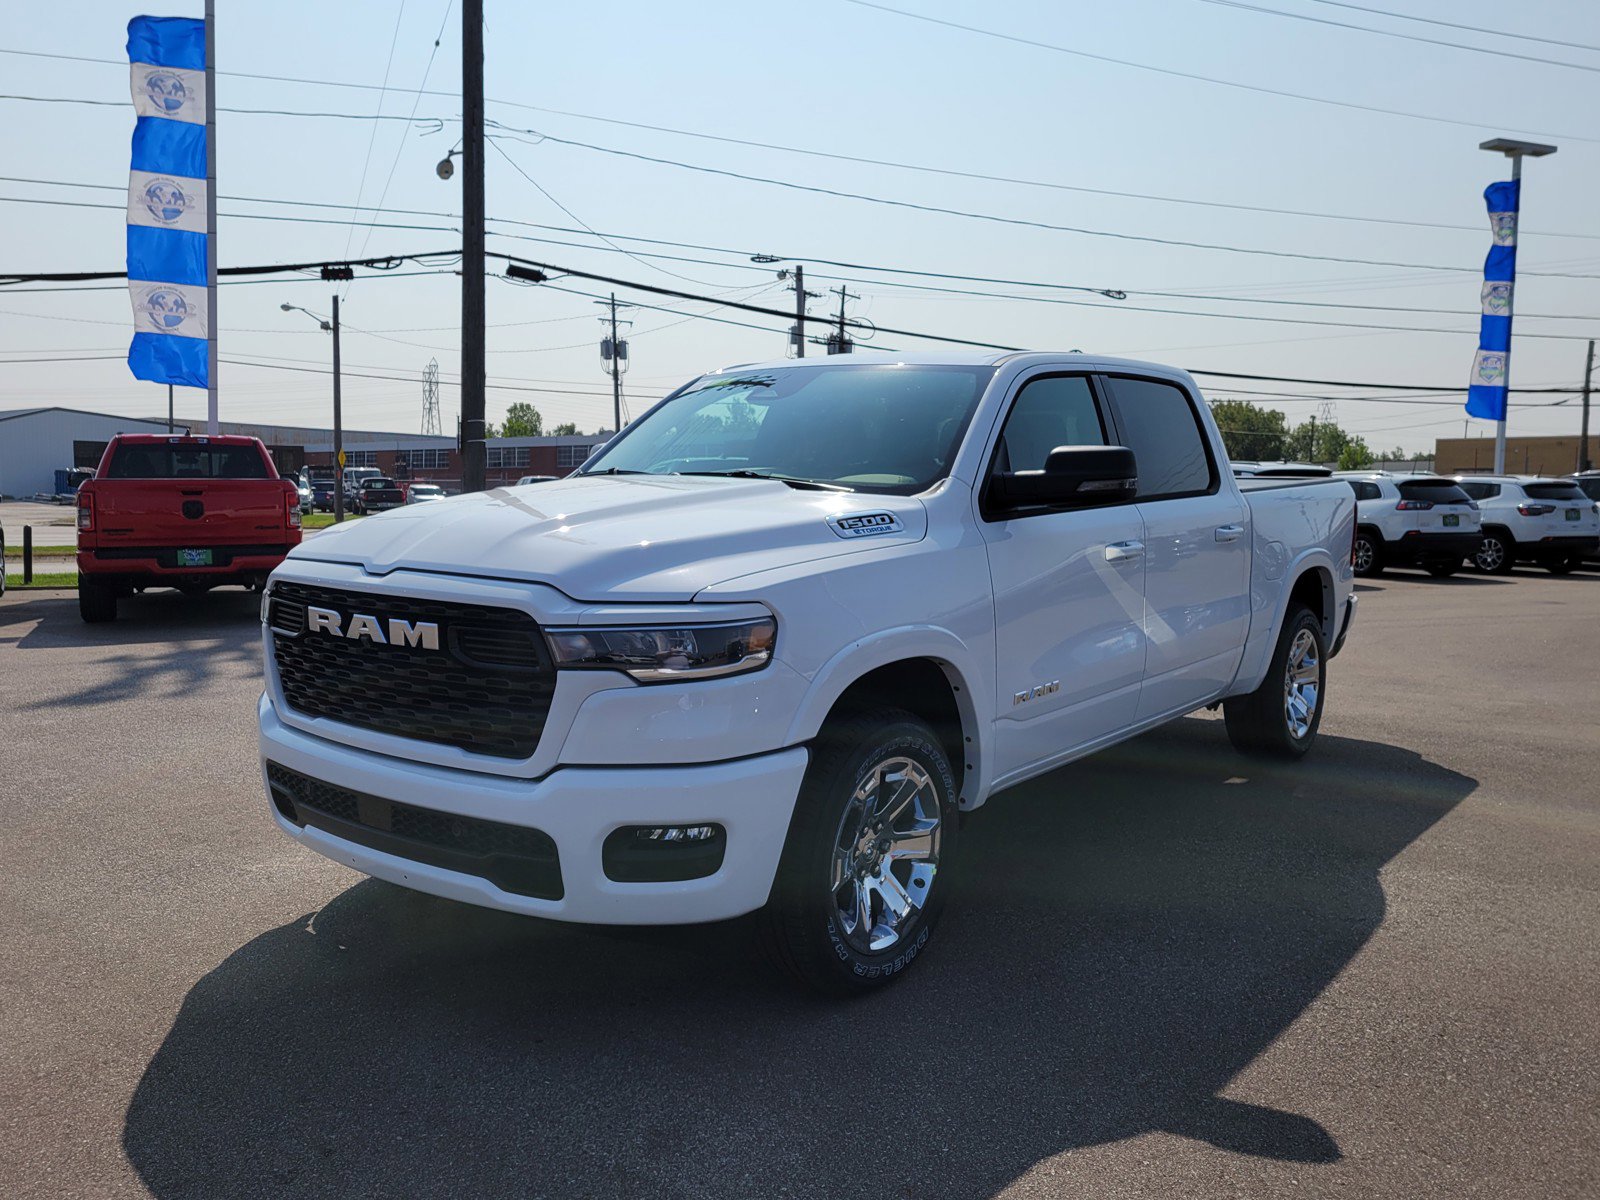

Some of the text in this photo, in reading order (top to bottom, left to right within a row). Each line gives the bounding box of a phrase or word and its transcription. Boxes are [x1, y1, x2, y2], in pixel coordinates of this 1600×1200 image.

[839, 516, 890, 529] 1500
[307, 605, 440, 650] RAM
[1013, 680, 1060, 706] RAM
[853, 925, 930, 979] DUELER
